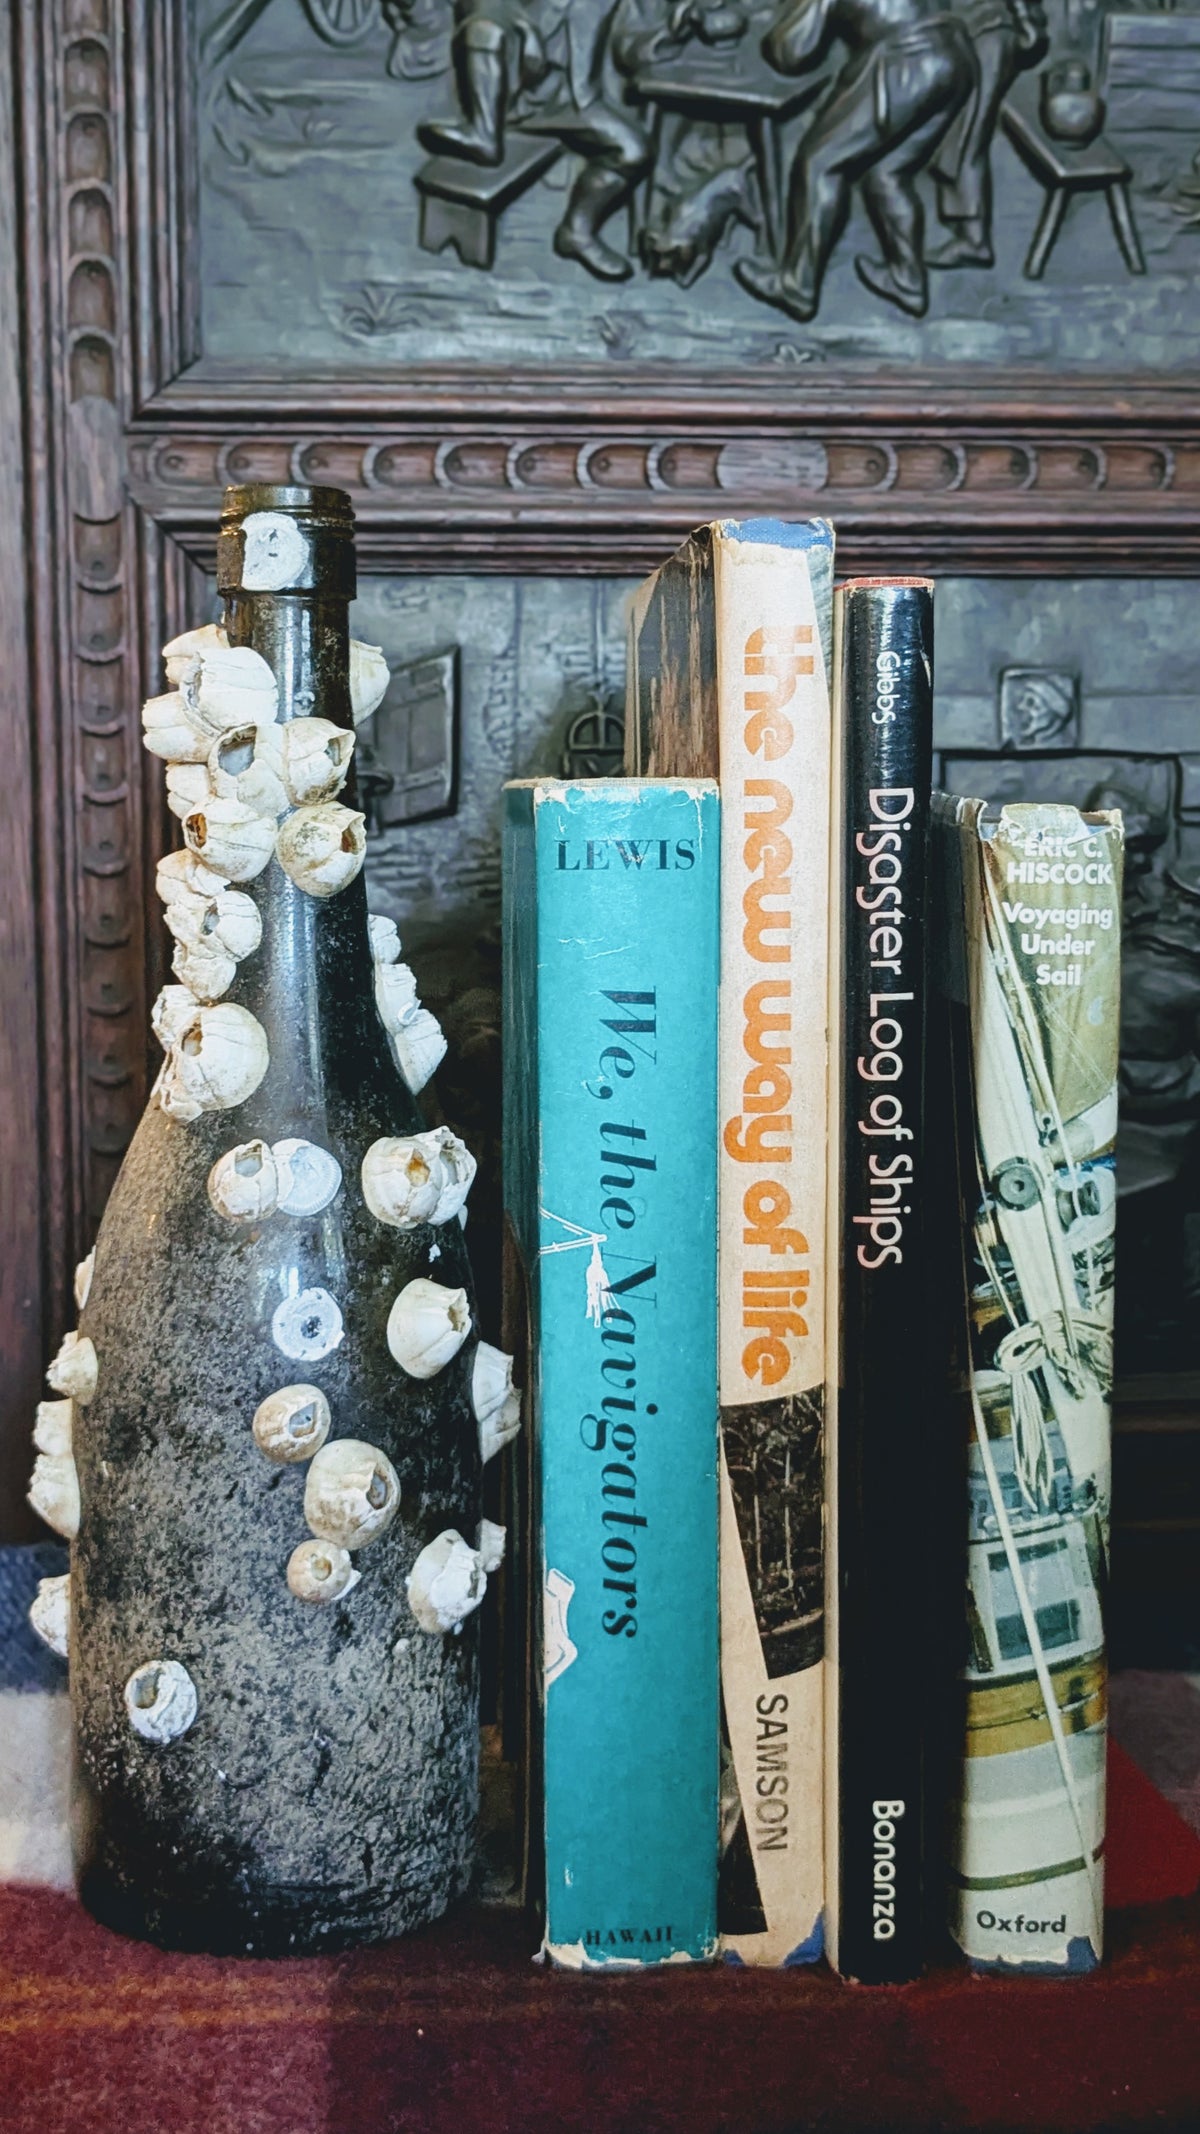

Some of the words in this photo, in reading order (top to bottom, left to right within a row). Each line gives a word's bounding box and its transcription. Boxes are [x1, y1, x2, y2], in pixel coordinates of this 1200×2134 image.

[743, 624, 815, 762] the
[872, 649, 901, 726] Gibbs
[554, 838, 696, 871] LEWIS
[742, 778, 794, 963] new
[855, 786, 915, 976] Disaster
[1006, 861, 1114, 885] HISCOCK
[1023, 835, 1076, 858] ERIC
[1083, 837, 1103, 858] C.
[1002, 901, 1114, 930] Voyaging
[1021, 933, 1095, 956] Under
[1035, 963, 1082, 987] Sail
[582, 985, 658, 1101] We,
[723, 979, 793, 1163] way
[857, 991, 915, 1082] Log
[857, 1094, 914, 1141] of
[600, 1119, 658, 1231] the
[743, 1179, 810, 1255] of
[852, 1153, 914, 1269] Ships
[741, 1268, 810, 1387] life
[579, 1254, 660, 1639] Navigators
[755, 1692, 789, 1852] SAMSON
[871, 1799, 906, 1941] Bonanza
[585, 1926, 673, 1946] HAWAII
[975, 1909, 1067, 1934] Oxford
